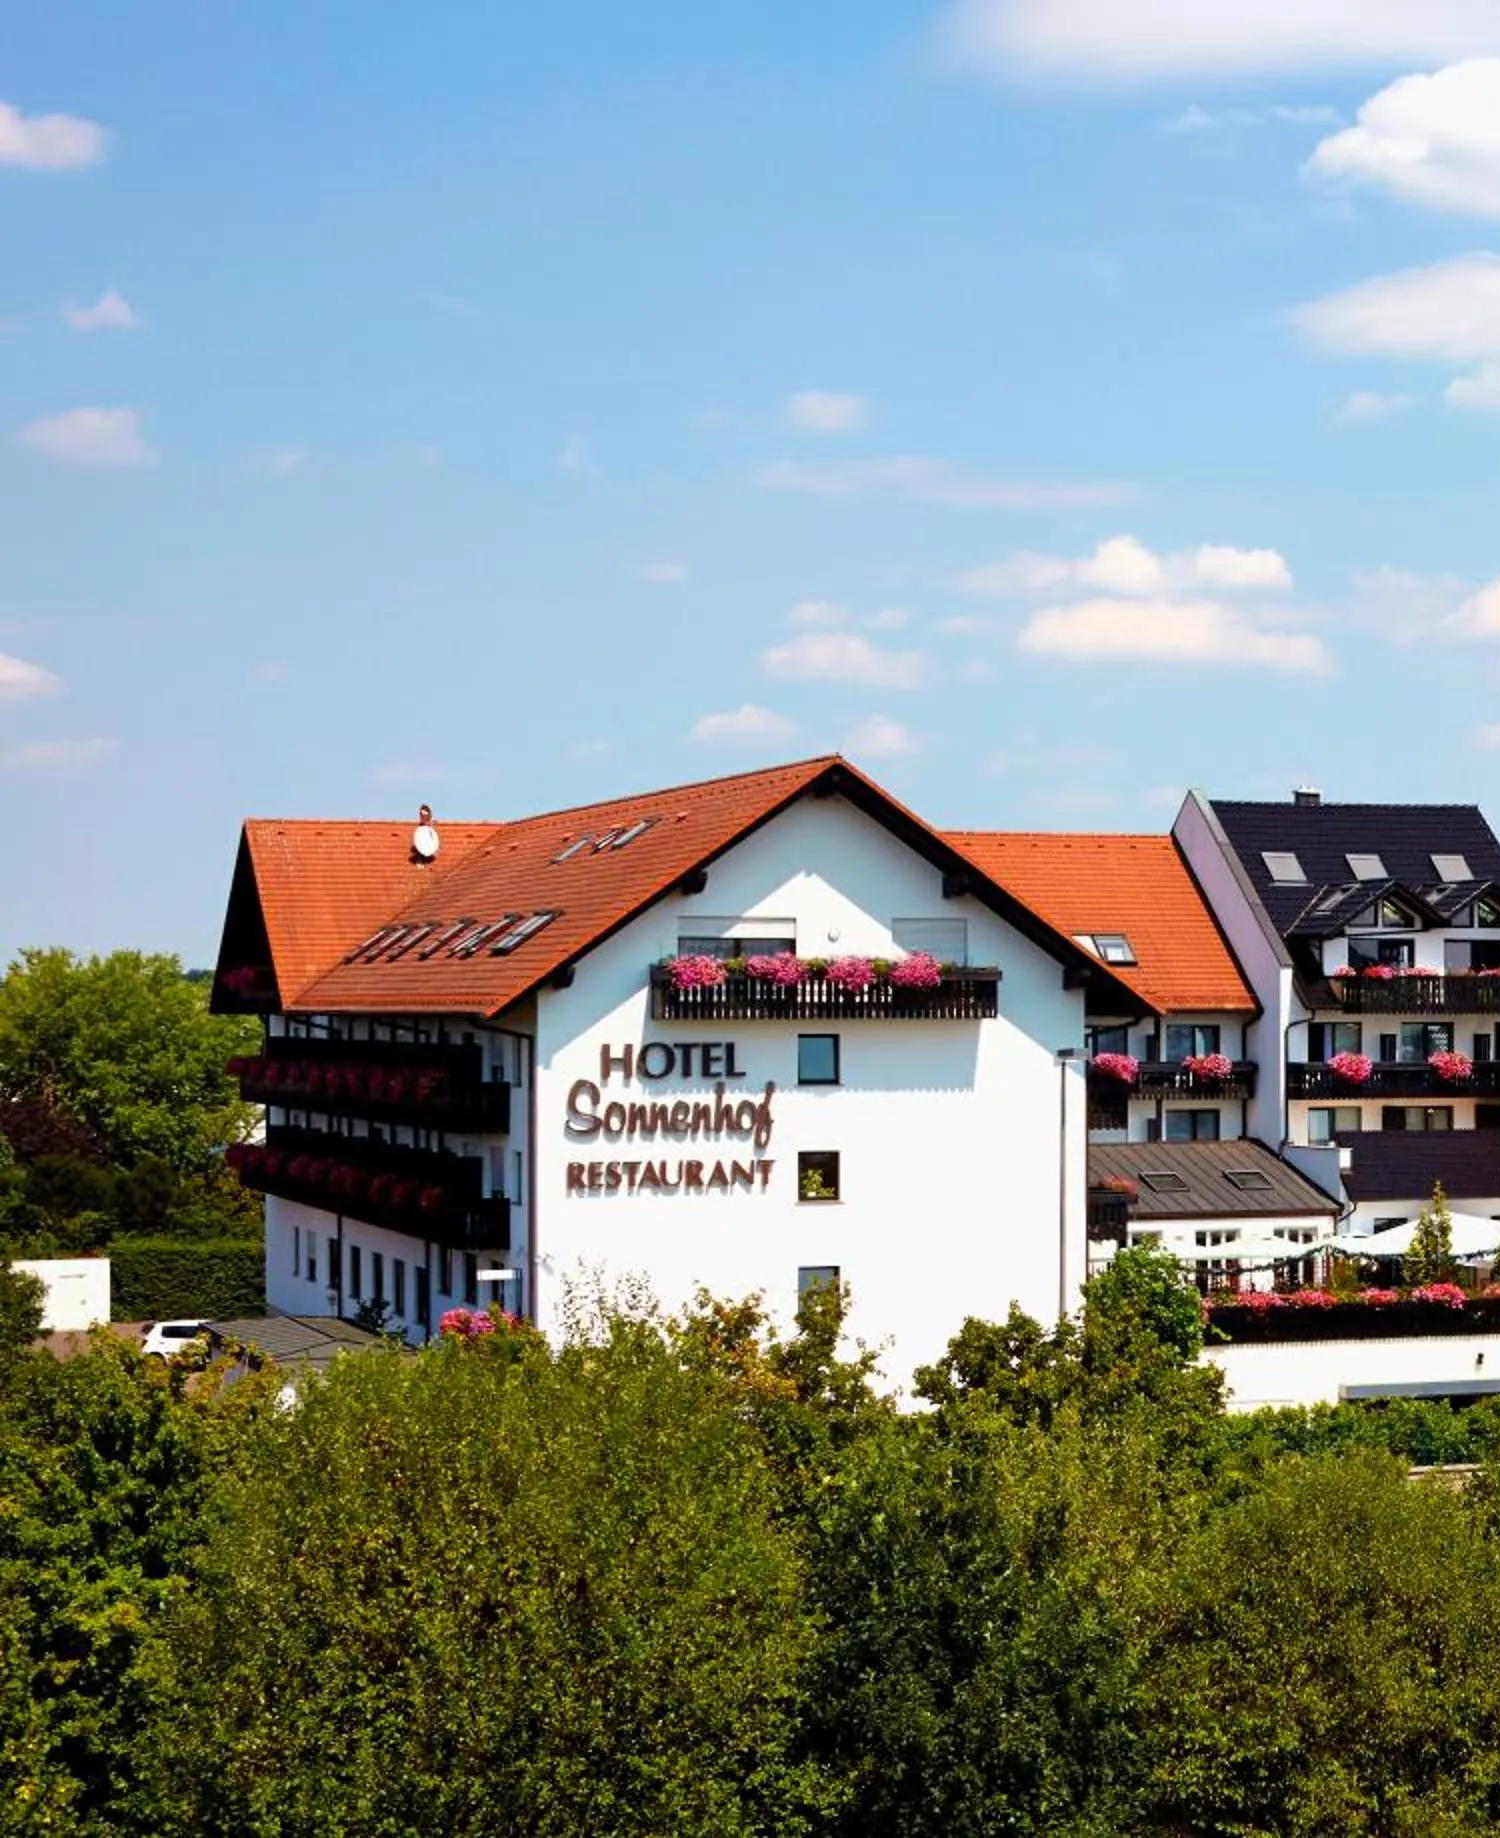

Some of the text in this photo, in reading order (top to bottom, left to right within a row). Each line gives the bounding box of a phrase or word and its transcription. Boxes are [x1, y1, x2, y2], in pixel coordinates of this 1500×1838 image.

[600, 1041, 746, 1082] HOTEL
[565, 1079, 775, 1150] Sonnenhof
[566, 1159, 775, 1192] RESTAURANT
